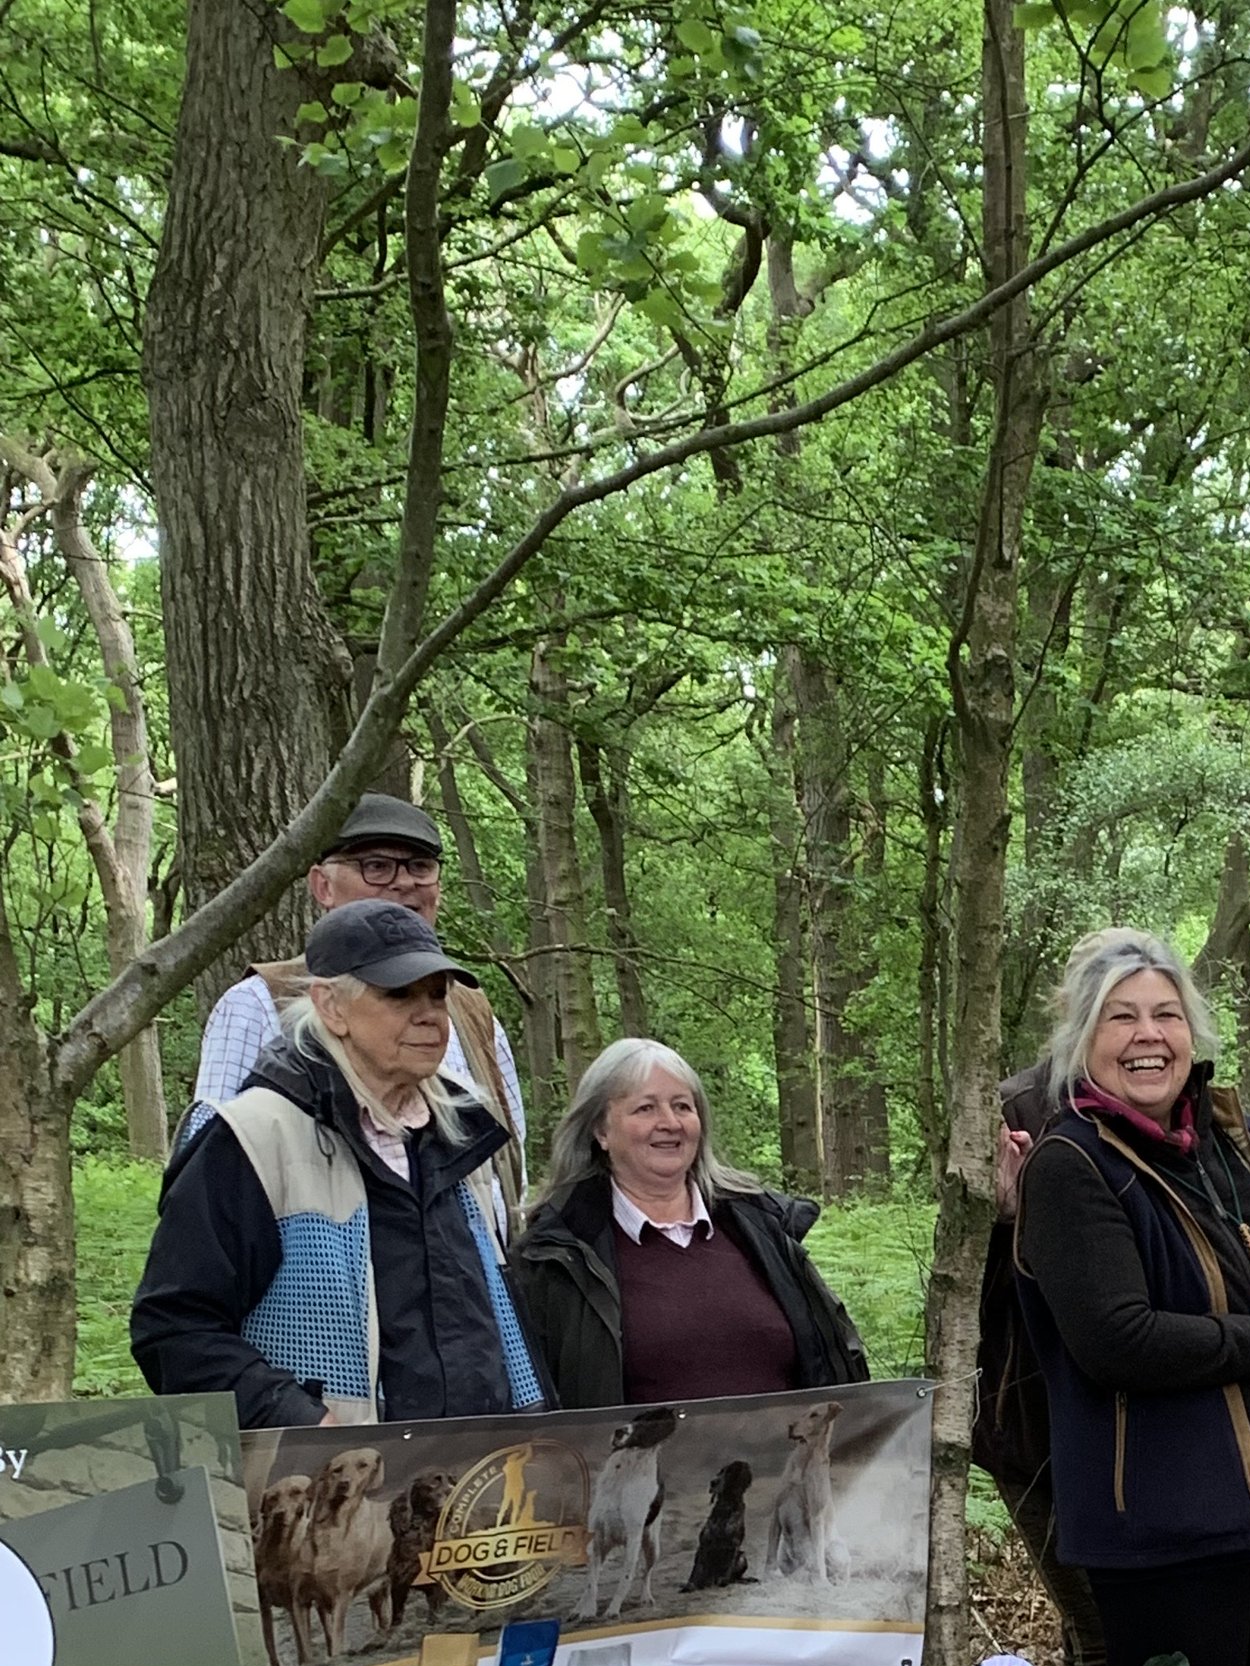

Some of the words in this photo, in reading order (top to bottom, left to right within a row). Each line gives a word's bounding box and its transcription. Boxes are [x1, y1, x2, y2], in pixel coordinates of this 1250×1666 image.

[450, 1465, 497, 1534] COMPLETE
[436, 1541, 490, 1567] DOG
[493, 1538, 508, 1559] &
[513, 1531, 577, 1556] FIELD
